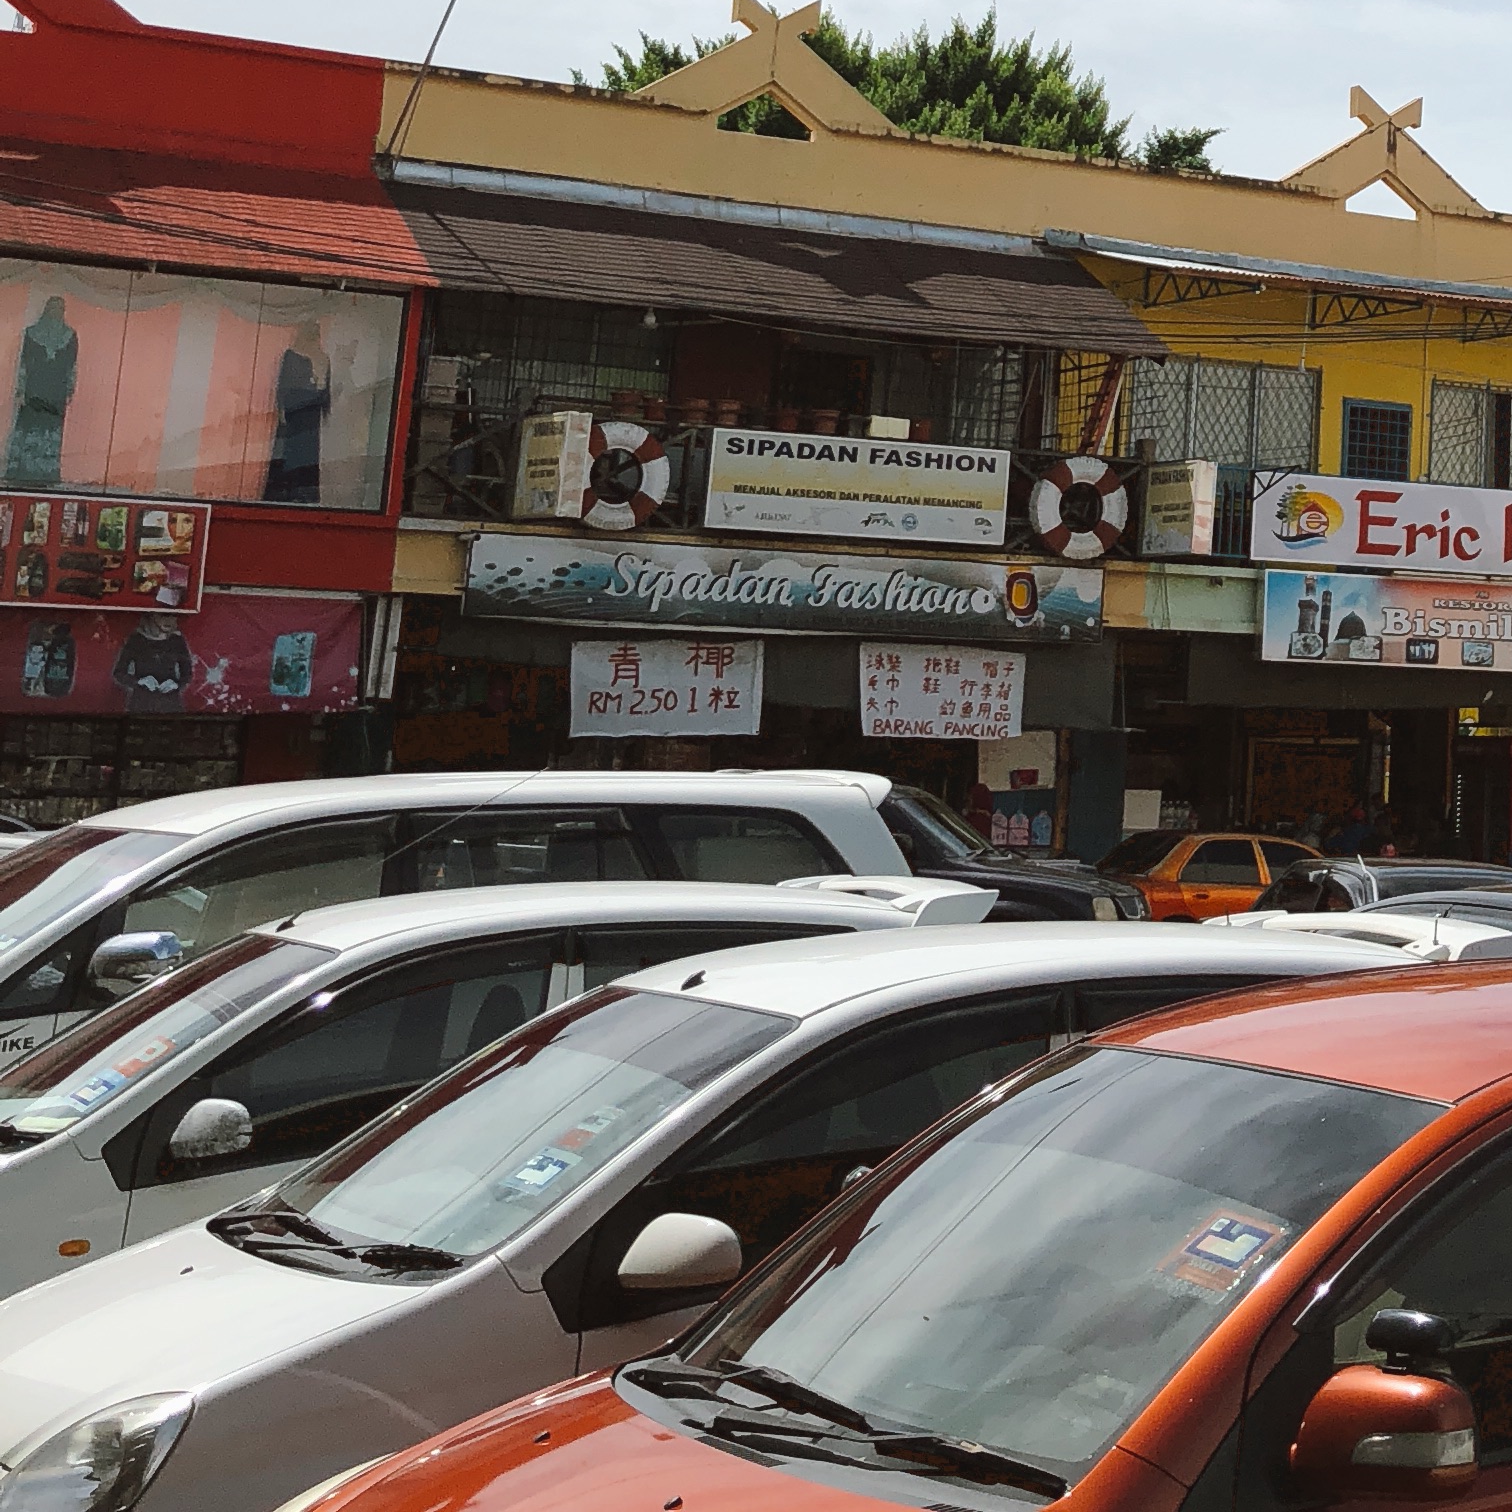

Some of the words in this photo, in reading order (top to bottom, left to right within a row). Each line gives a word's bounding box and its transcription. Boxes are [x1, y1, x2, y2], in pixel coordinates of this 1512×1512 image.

[726, 437, 859, 464] SIPADAN
[869, 447, 997, 473] FASHION
[733, 484, 782, 497] MENJUAL
[785, 487, 837, 501] AKSESORI
[839, 491, 860, 502] DAN
[862, 492, 921, 506] PERALATAN
[923, 496, 983, 510] MEMANCING
[1354, 489, 1483, 561] Eric
[605, 551, 792, 613] Sipadan
[808, 563, 977, 616] Fashion
[588, 691, 623, 714] RM
[629, 688, 679, 715] 2.50
[872, 718, 934, 735] BARANG
[944, 721, 1009, 739] PANCING
[0, 1036, 35, 1053] IKE
